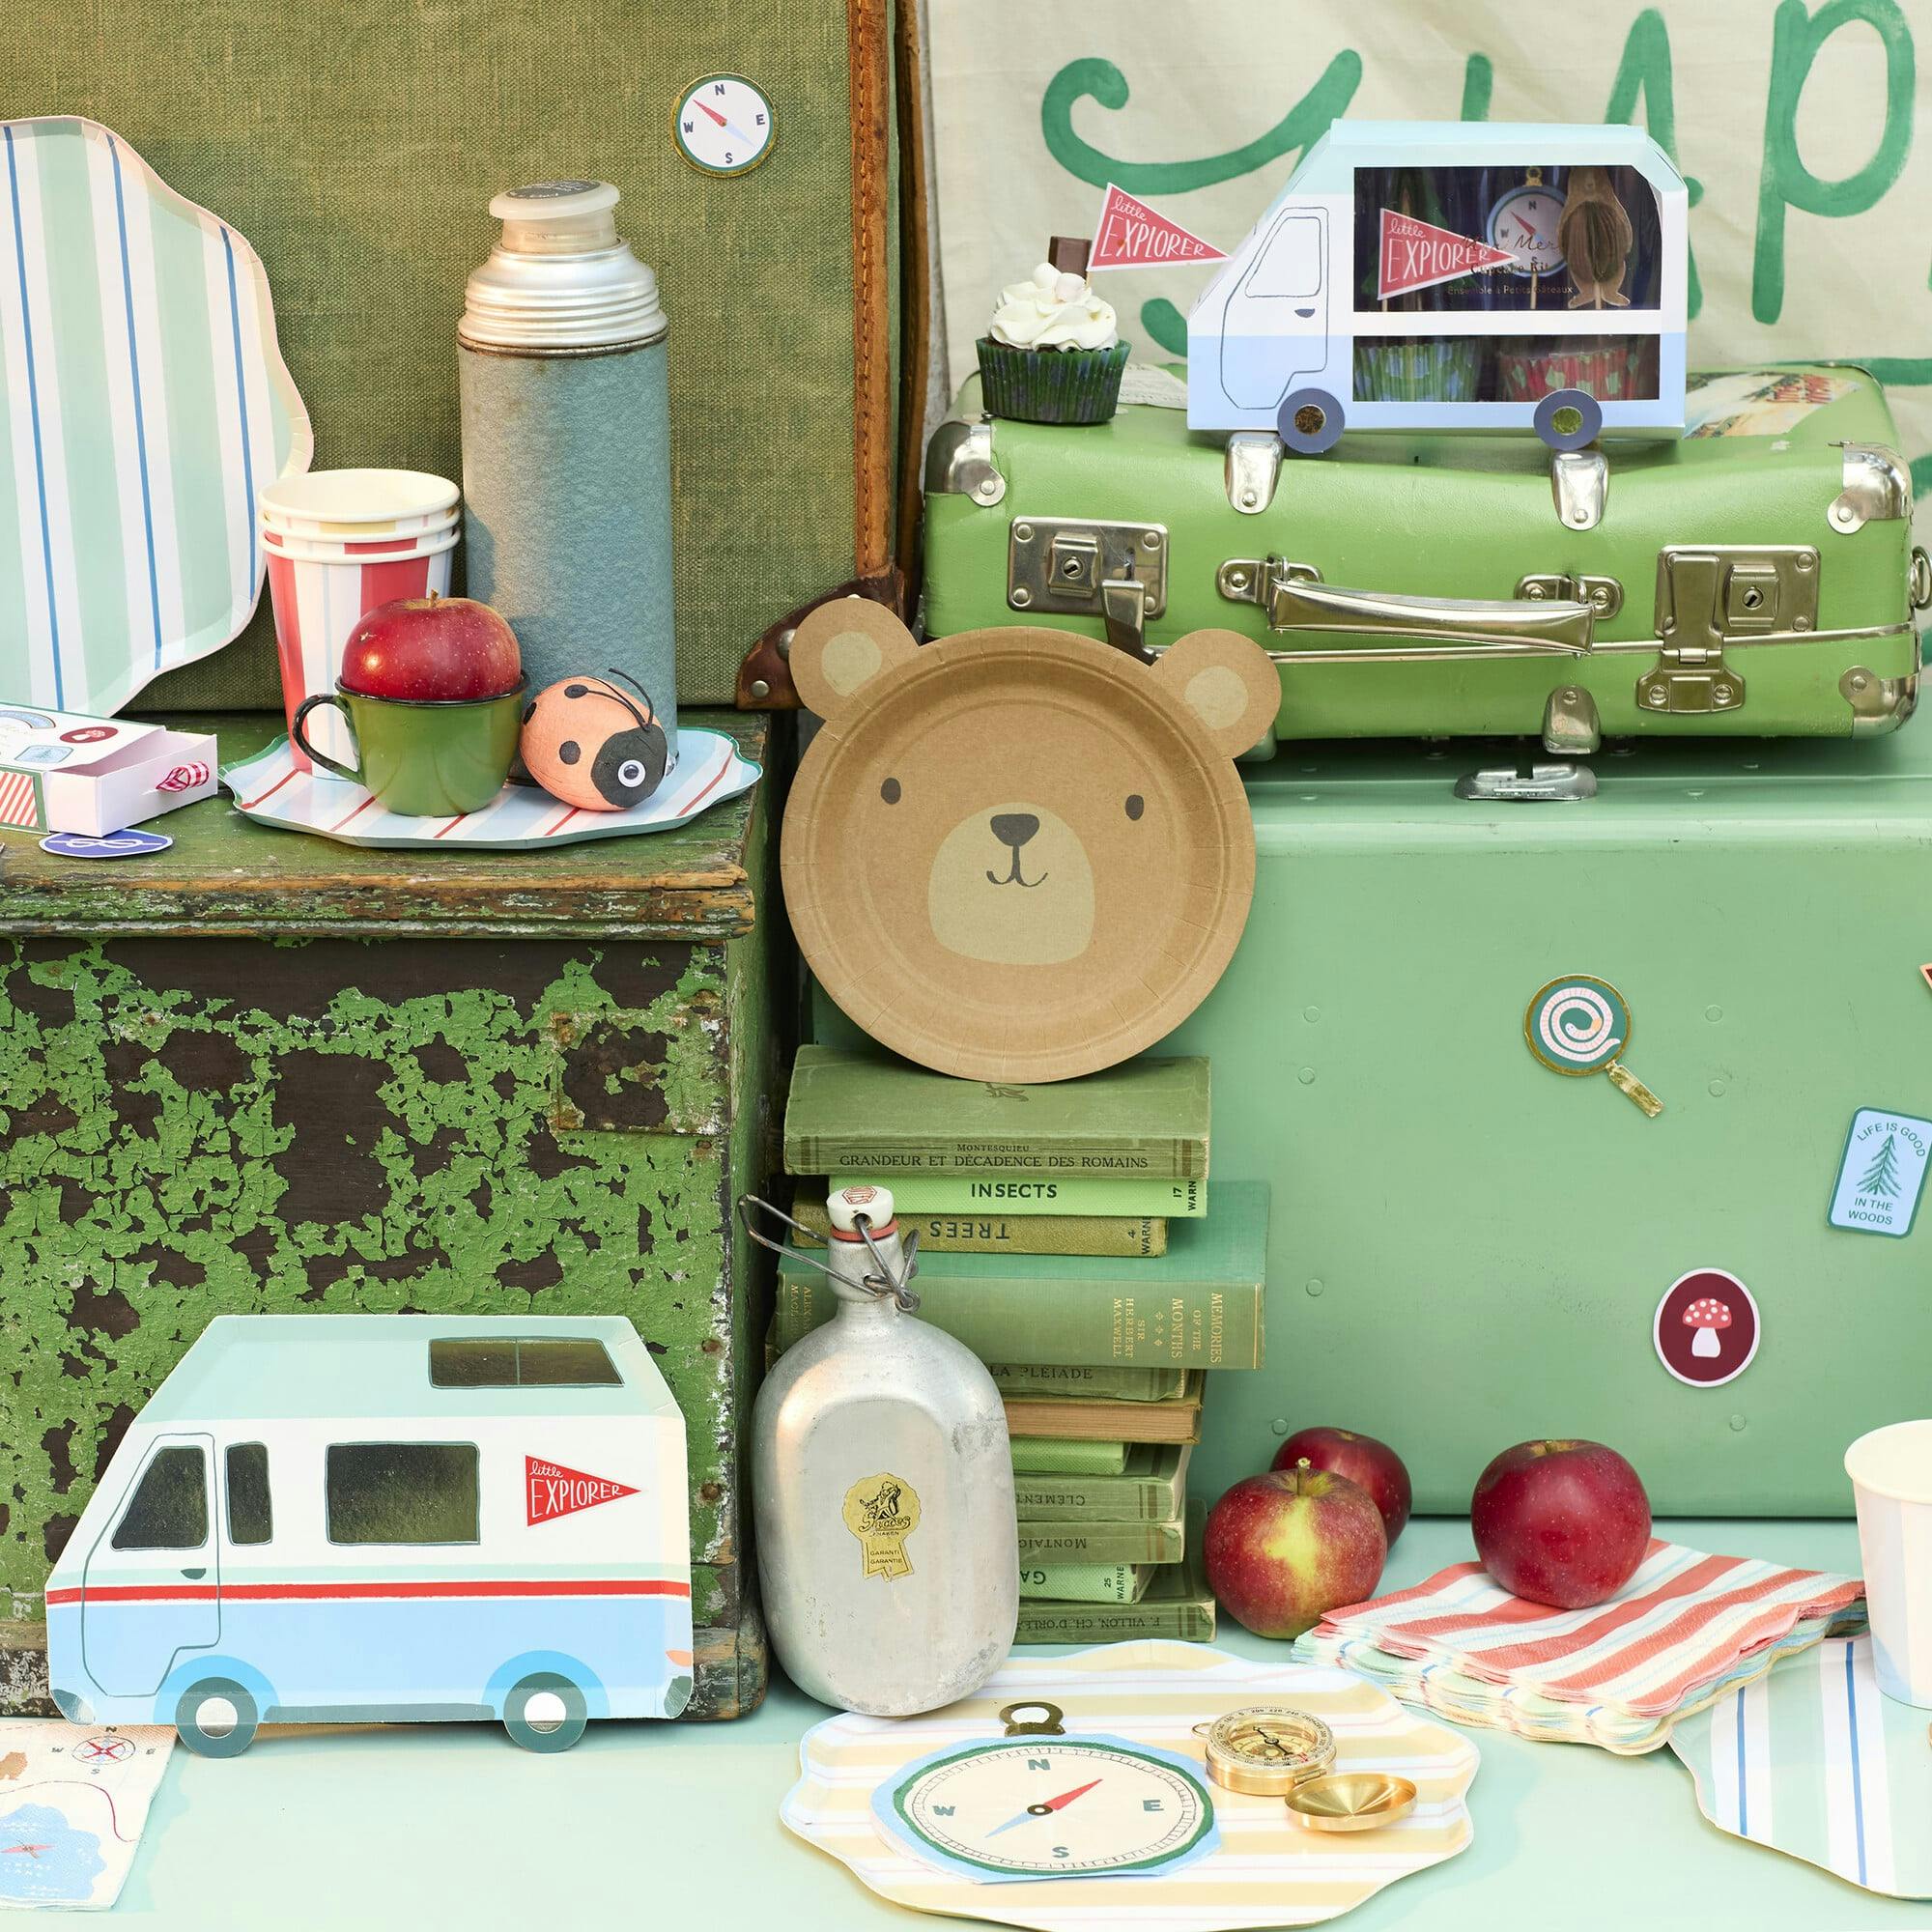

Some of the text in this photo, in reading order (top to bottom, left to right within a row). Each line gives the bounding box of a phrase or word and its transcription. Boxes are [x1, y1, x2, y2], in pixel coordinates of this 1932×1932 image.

[714, 83, 725, 96] N
[683, 121, 694, 133] W
[755, 113, 766, 126] E
[724, 152, 733, 164] S
[1110, 195, 1148, 221] little
[1099, 213, 1206, 259] EXPLORER
[1387, 219, 1426, 239] little
[1386, 238, 1492, 283] EXPLORER
[956, 1144, 1030, 1152] MONTESQUIEU
[1857, 1122, 1926, 1157] LIFE IS GOOD
[839, 1153, 1149, 1169] GRANDEUR ET DÉCADENCE DES ROMAINS
[971, 1182, 1058, 1198] INSECTS
[1173, 1186, 1182, 1198] 17
[1854, 1197, 1894, 1212] IN THE
[1847, 1209, 1893, 1226] WOODS
[929, 1220, 1010, 1239] TREES
[1113, 1297, 1122, 1358] MAXWELL
[1124, 1297, 1134, 1359] HERBERT
[1137, 1320, 1146, 1342] SIR
[1171, 1297, 1184, 1359] MONTHS
[1192, 1309, 1202, 1350] OF THE
[1209, 1293, 1223, 1364] MEMORIES
[528, 1460, 564, 1478] little
[530, 1478, 624, 1519] EXPLORER
[1103, 1577, 1111, 1588] 25
[1116, 1565, 1124, 1600] WARNE
[1027, 1758, 1051, 1772] N
[932, 1804, 956, 1817] W
[1143, 1799, 1165, 1812] E
[1051, 1846, 1070, 1860] S
